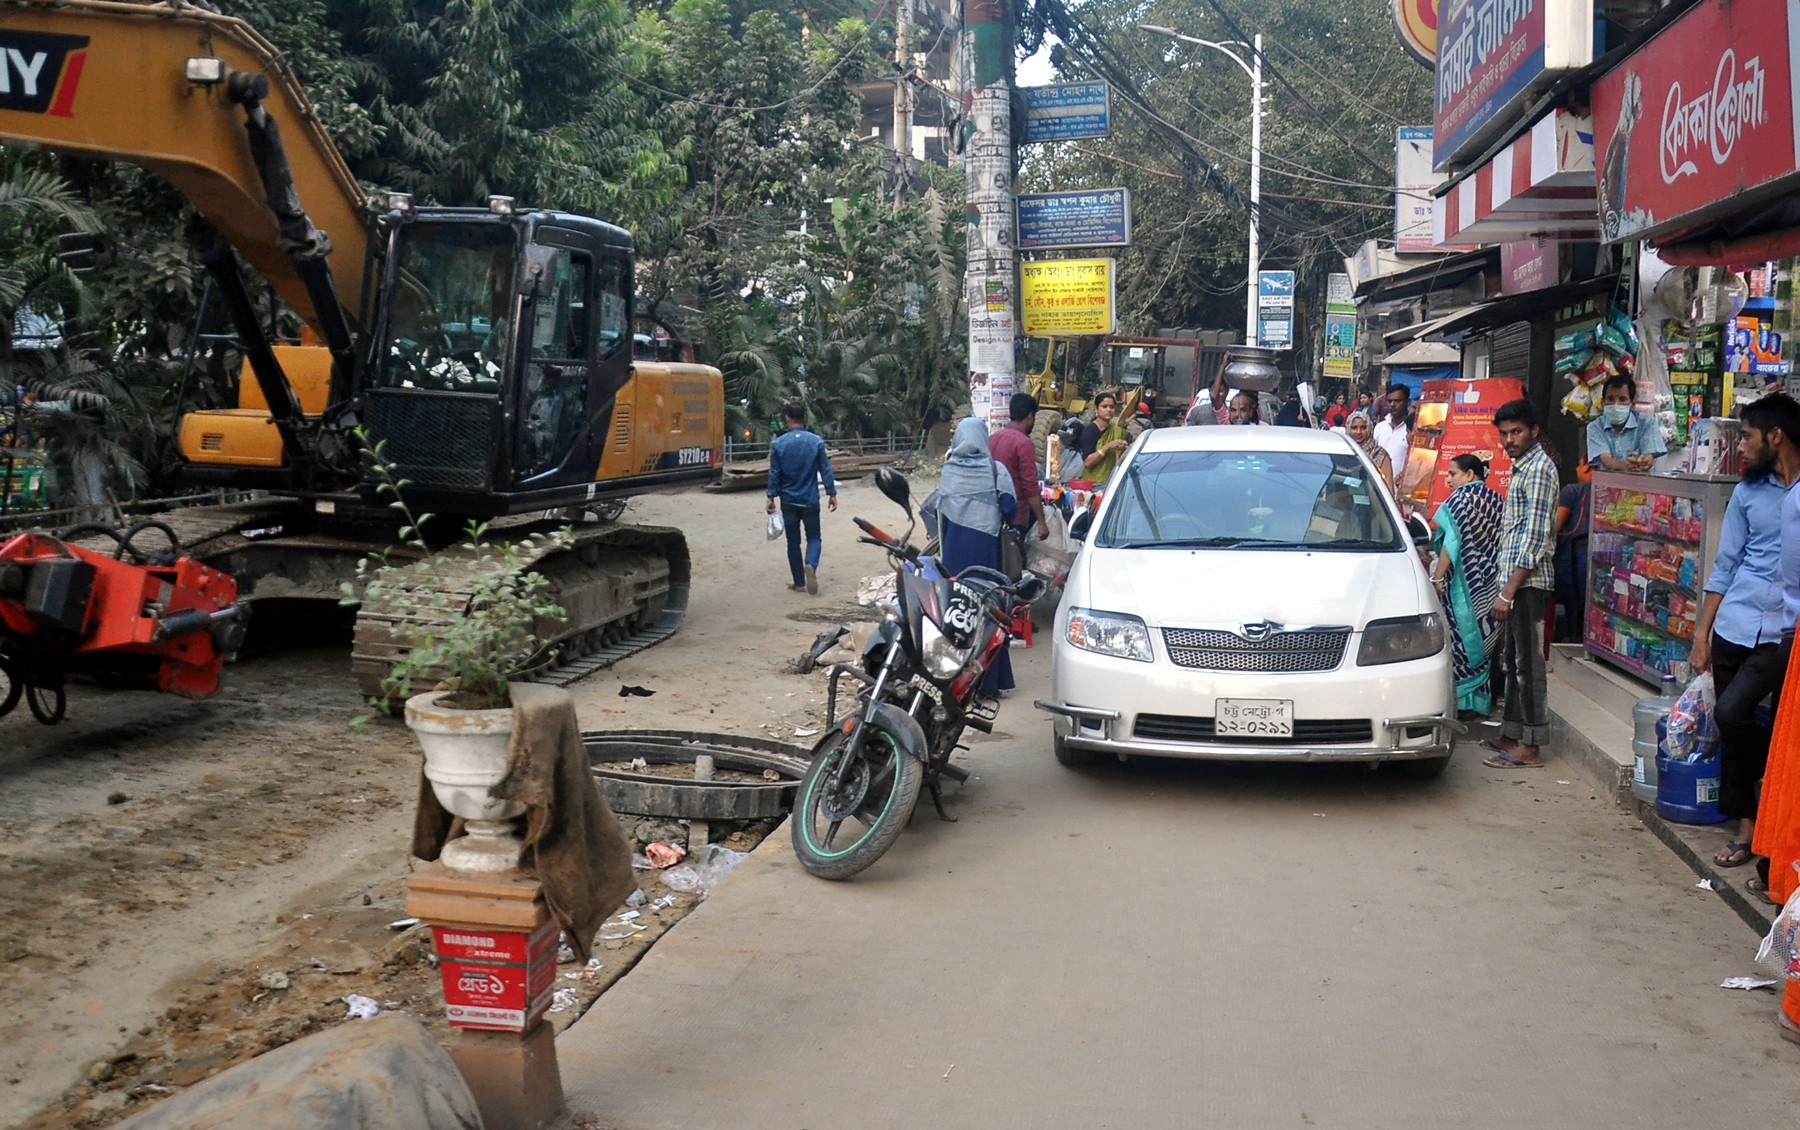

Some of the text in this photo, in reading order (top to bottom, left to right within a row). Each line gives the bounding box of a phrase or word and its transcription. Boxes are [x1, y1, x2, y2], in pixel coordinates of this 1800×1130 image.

[1439, 5, 1475, 114] নিমাই
[1062, 86, 1086, 97] মোহন
[1089, 84, 1104, 95] নাথ
[1047, 198, 1059, 206] ডাঃ
[1061, 197, 1077, 206] স্বপন
[1079, 195, 1097, 206] কুমার
[1100, 192, 1122, 204] চৌধুরী
[973, 335, 997, 344] Design
[910, 673, 942, 701] PRESS
[1224, 704, 1239, 718] চট্ট
[1218, 721, 1290, 734] ১২-০২৯১
[443, 933, 495, 948] DIAMOND
